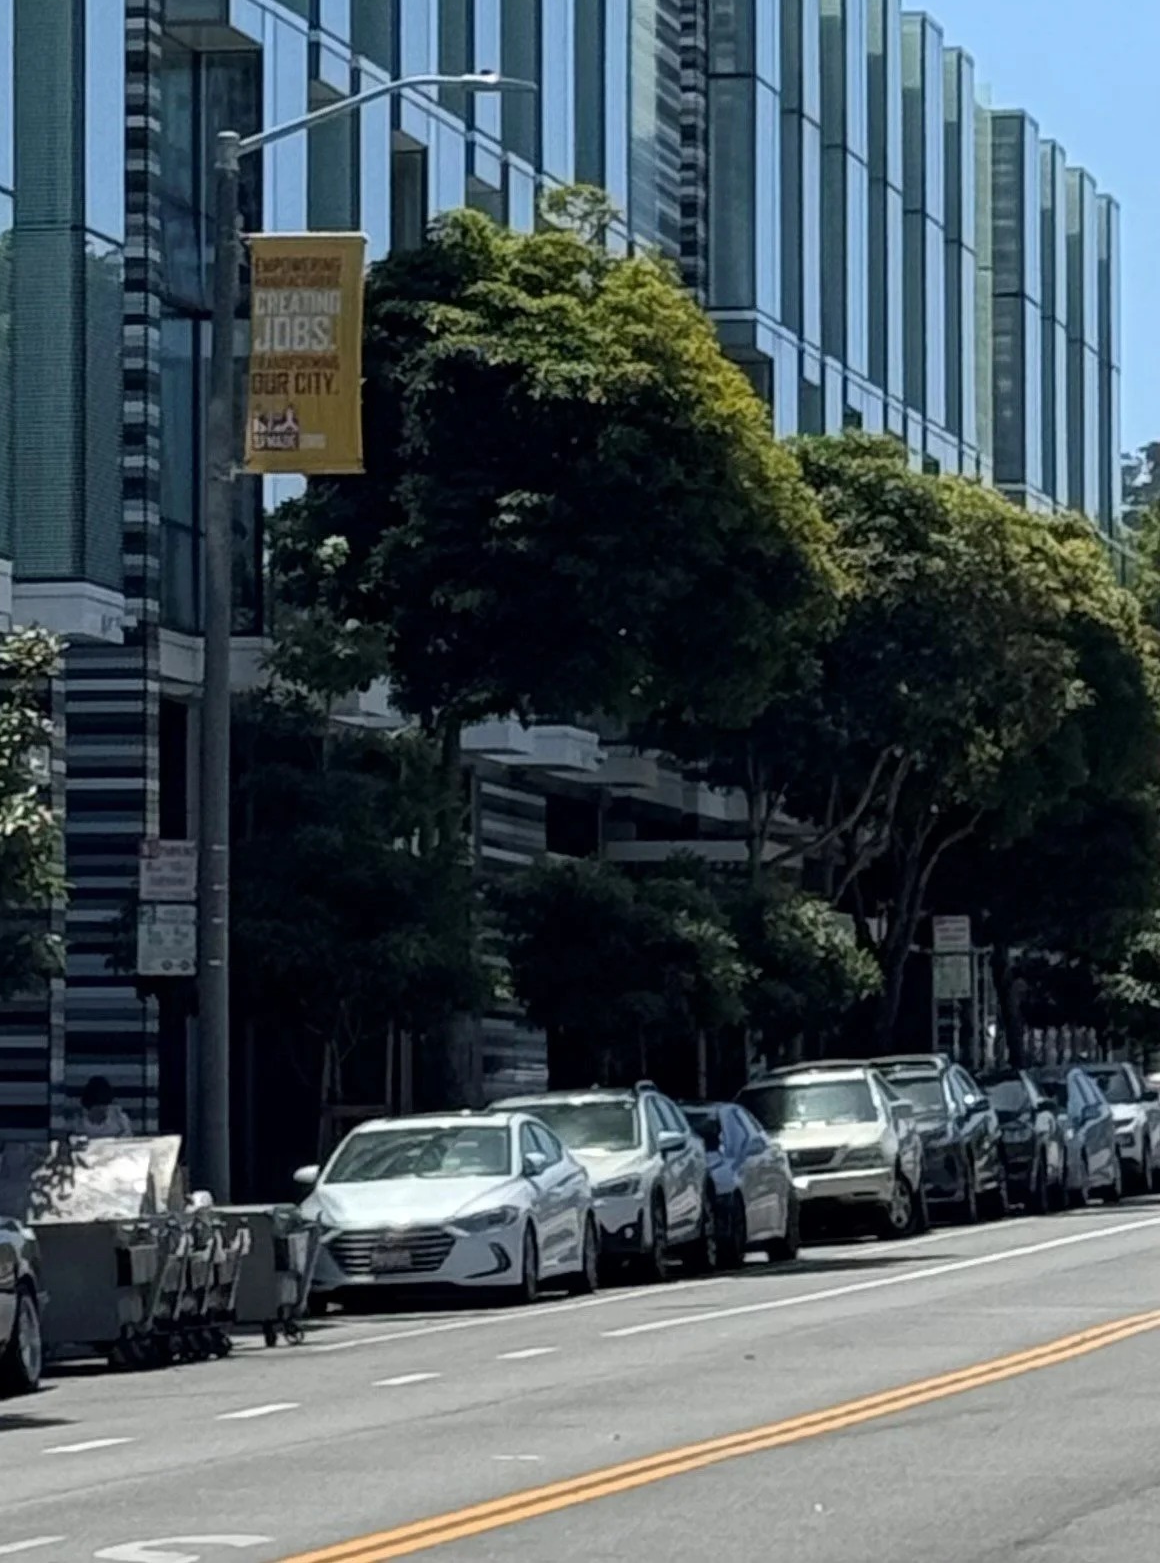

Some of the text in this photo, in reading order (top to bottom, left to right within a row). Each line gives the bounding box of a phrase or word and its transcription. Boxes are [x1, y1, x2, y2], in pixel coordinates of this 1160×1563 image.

[254, 290, 341, 314] CREATING
[253, 316, 338, 351] JOBS.
[251, 372, 289, 394] OUR
